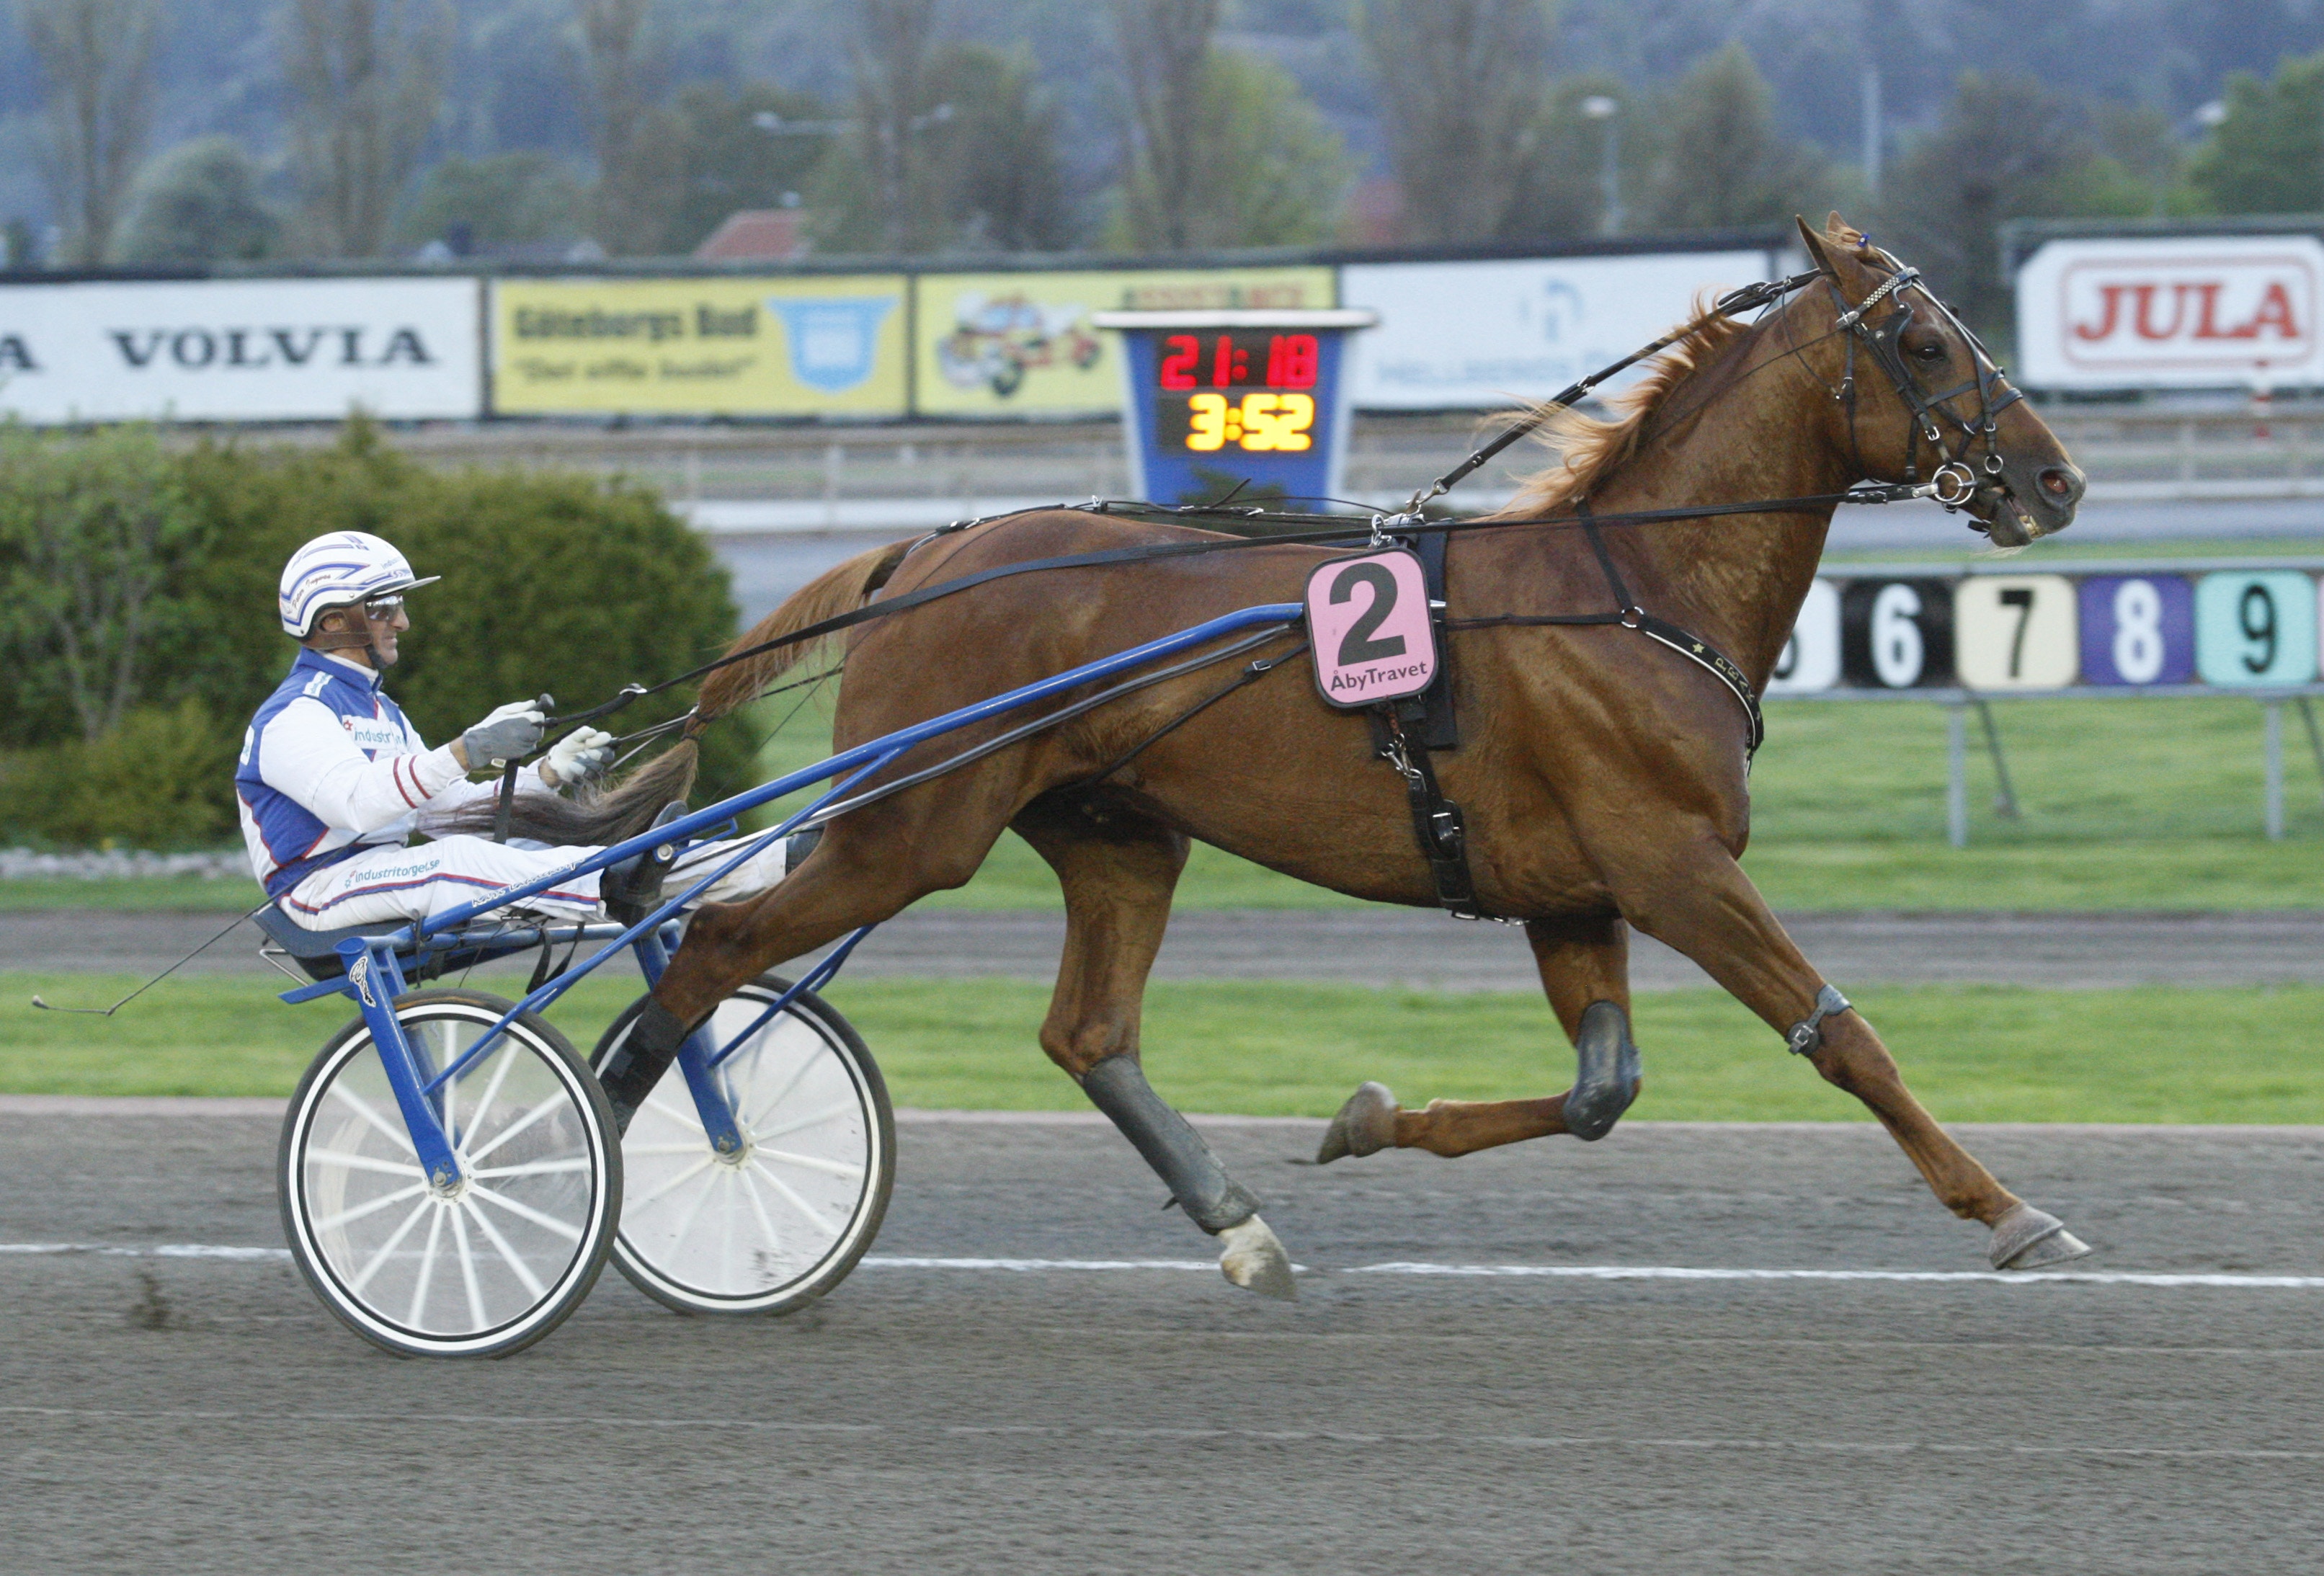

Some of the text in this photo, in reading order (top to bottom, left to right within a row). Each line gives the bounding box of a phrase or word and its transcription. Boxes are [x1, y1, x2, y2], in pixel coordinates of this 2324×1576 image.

[2073, 282, 2299, 340] JULA
[110, 326, 439, 369] VOLVIA
[1160, 334, 1318, 391] 21:18
[1185, 393, 1314, 451] 3:52
[1329, 561, 1407, 667] 2
[1870, 583, 1924, 688] 6
[2000, 588, 2036, 679] 7
[2112, 578, 2164, 685] 8
[2238, 584, 2278, 675] 9
[1330, 661, 1428, 692] ÅbyTravet
